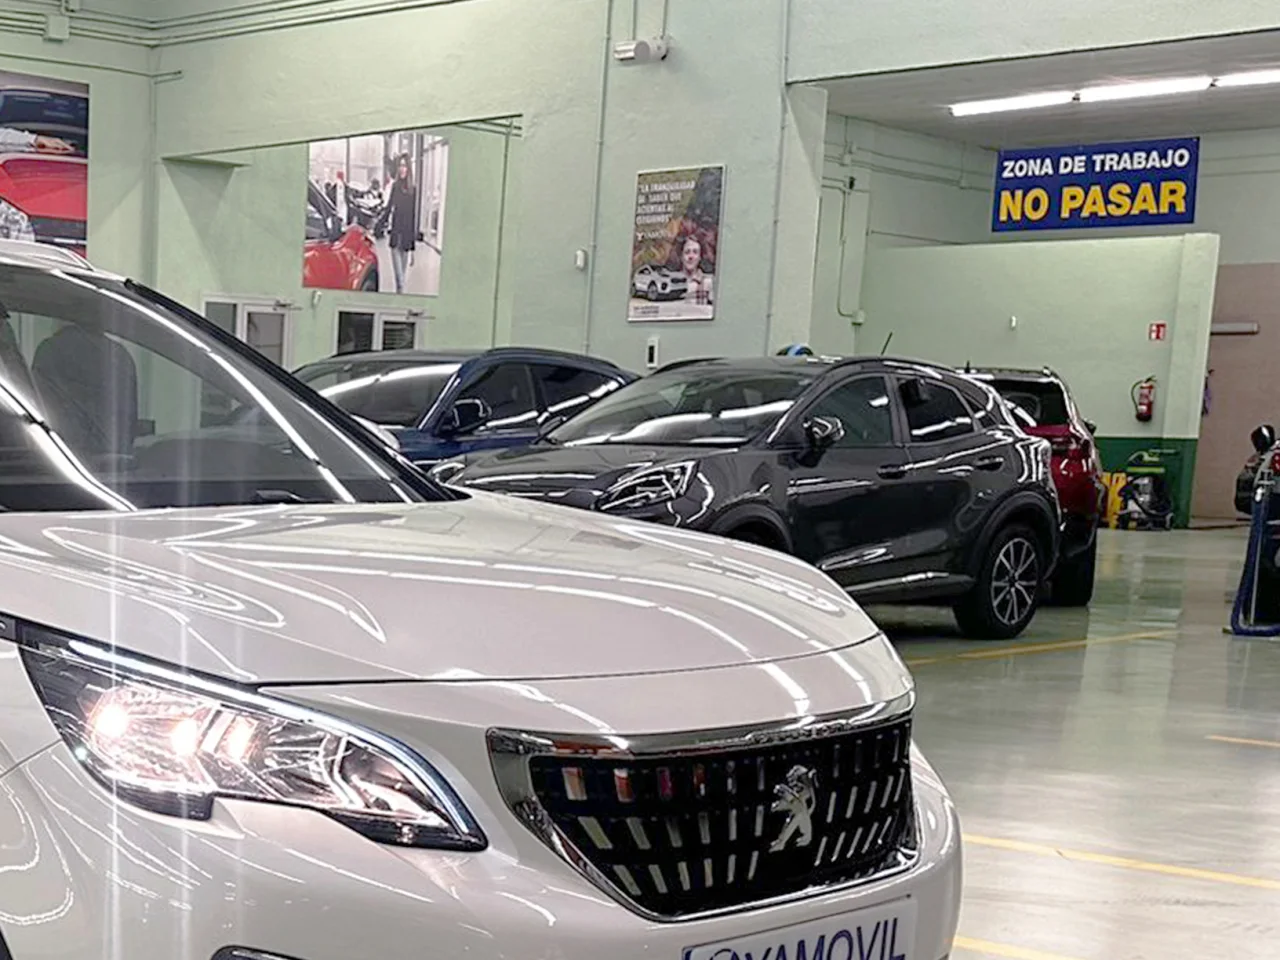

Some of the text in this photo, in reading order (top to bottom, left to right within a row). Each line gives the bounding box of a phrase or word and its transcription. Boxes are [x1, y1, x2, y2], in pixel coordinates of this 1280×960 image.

[1002, 148, 1190, 178] ZONA DE TRABAJO
[999, 180, 1187, 222] NO PASAR
